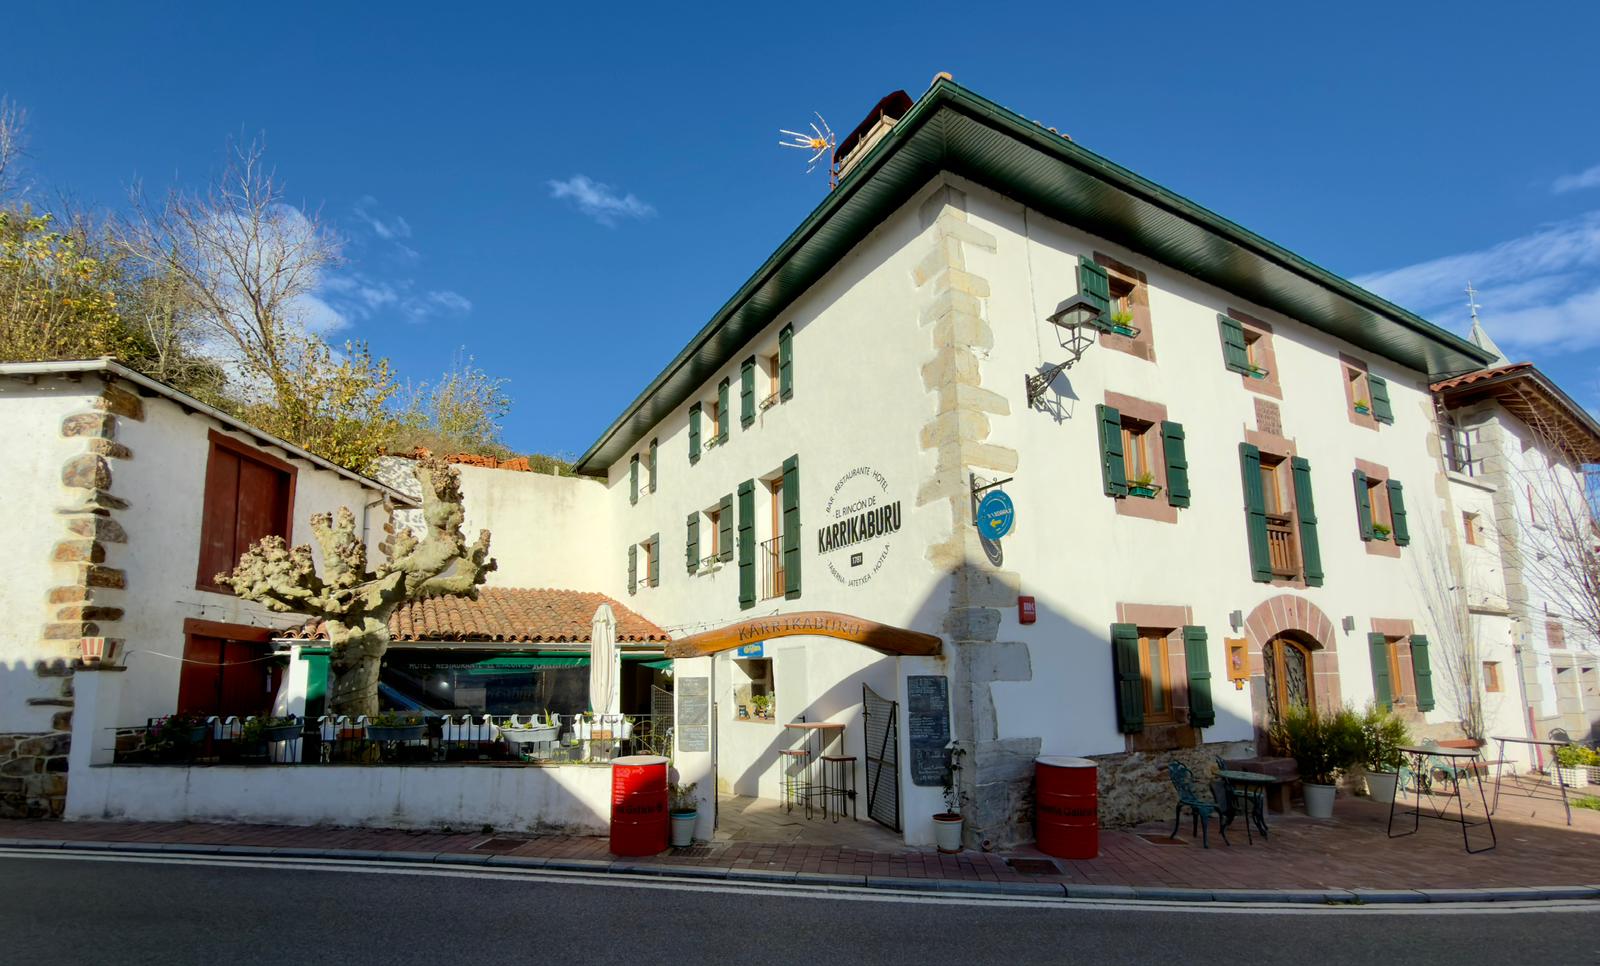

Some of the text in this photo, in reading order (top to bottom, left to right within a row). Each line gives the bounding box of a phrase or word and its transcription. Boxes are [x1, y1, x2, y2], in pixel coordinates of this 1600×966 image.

[834, 466, 871, 494] RESTAURANTE
[872, 470, 888, 493] HOTEL
[835, 509, 842, 519] EL
[868, 495, 876, 507] DE
[818, 500, 901, 554] KARRIKABURU
[848, 573, 872, 587] JATETXEA
[873, 544, 890, 573] HOTELA
[737, 617, 861, 640] KARRIKABURU
